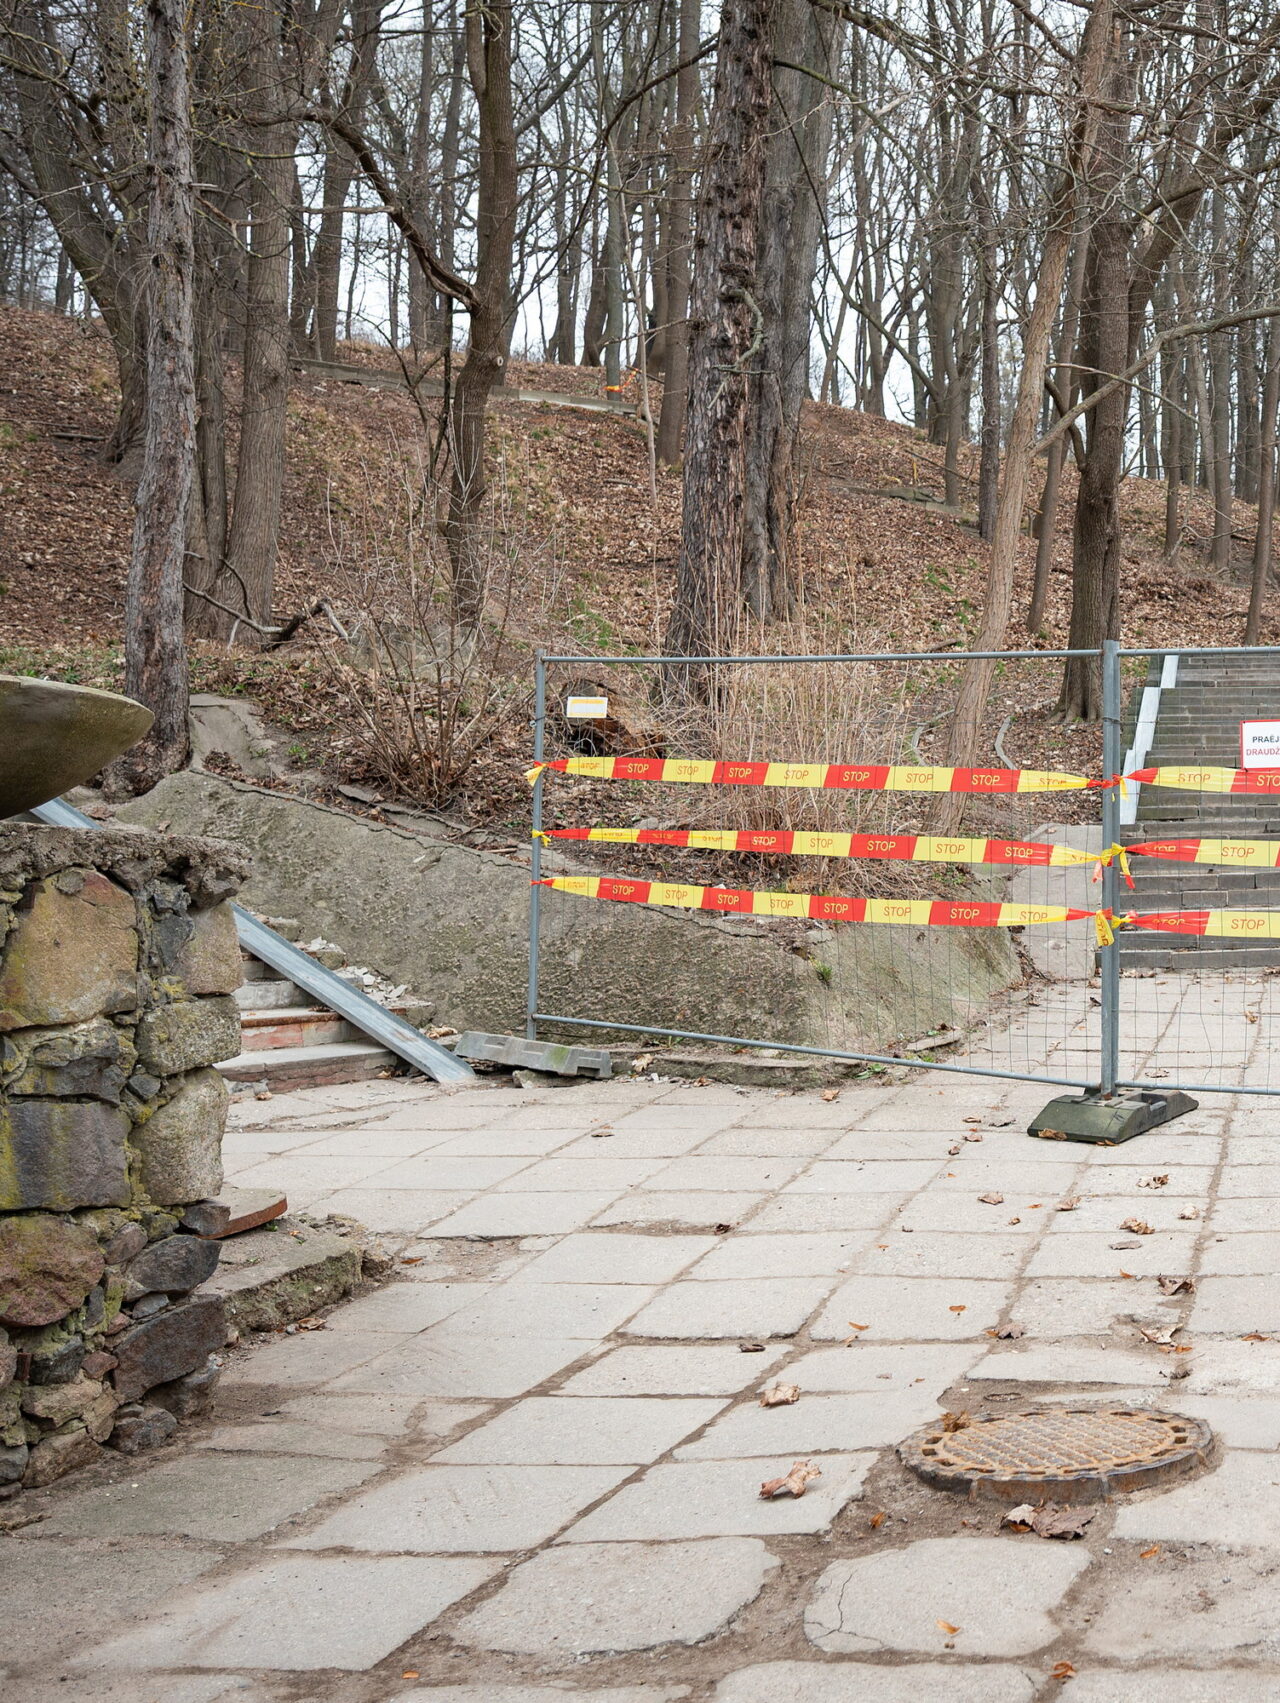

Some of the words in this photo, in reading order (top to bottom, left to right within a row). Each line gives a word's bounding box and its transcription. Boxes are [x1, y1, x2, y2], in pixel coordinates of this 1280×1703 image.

[627, 762, 649, 774] STOP
[677, 765, 699, 775] STOP
[728, 767, 752, 778] STOP
[784, 769, 809, 780] STOP
[843, 771, 870, 782] STOP
[905, 773, 933, 783] STOP
[971, 774, 1000, 786] STOP
[1178, 773, 1211, 783] STOP
[752, 836, 777, 847] STOP
[810, 838, 833, 849] STOP
[867, 840, 896, 851] STOP
[936, 844, 965, 854] STOP
[1005, 846, 1033, 858] STOP
[1221, 846, 1255, 858] STOP
[613, 884, 634, 895] STOP
[665, 889, 687, 900] STOP
[717, 894, 739, 905] STOP
[770, 899, 793, 909] STOP
[824, 903, 848, 914] STOP
[883, 906, 911, 917] STOP
[950, 908, 979, 919] STOP
[1020, 911, 1047, 921] STOP
[1231, 918, 1265, 930] STOP
